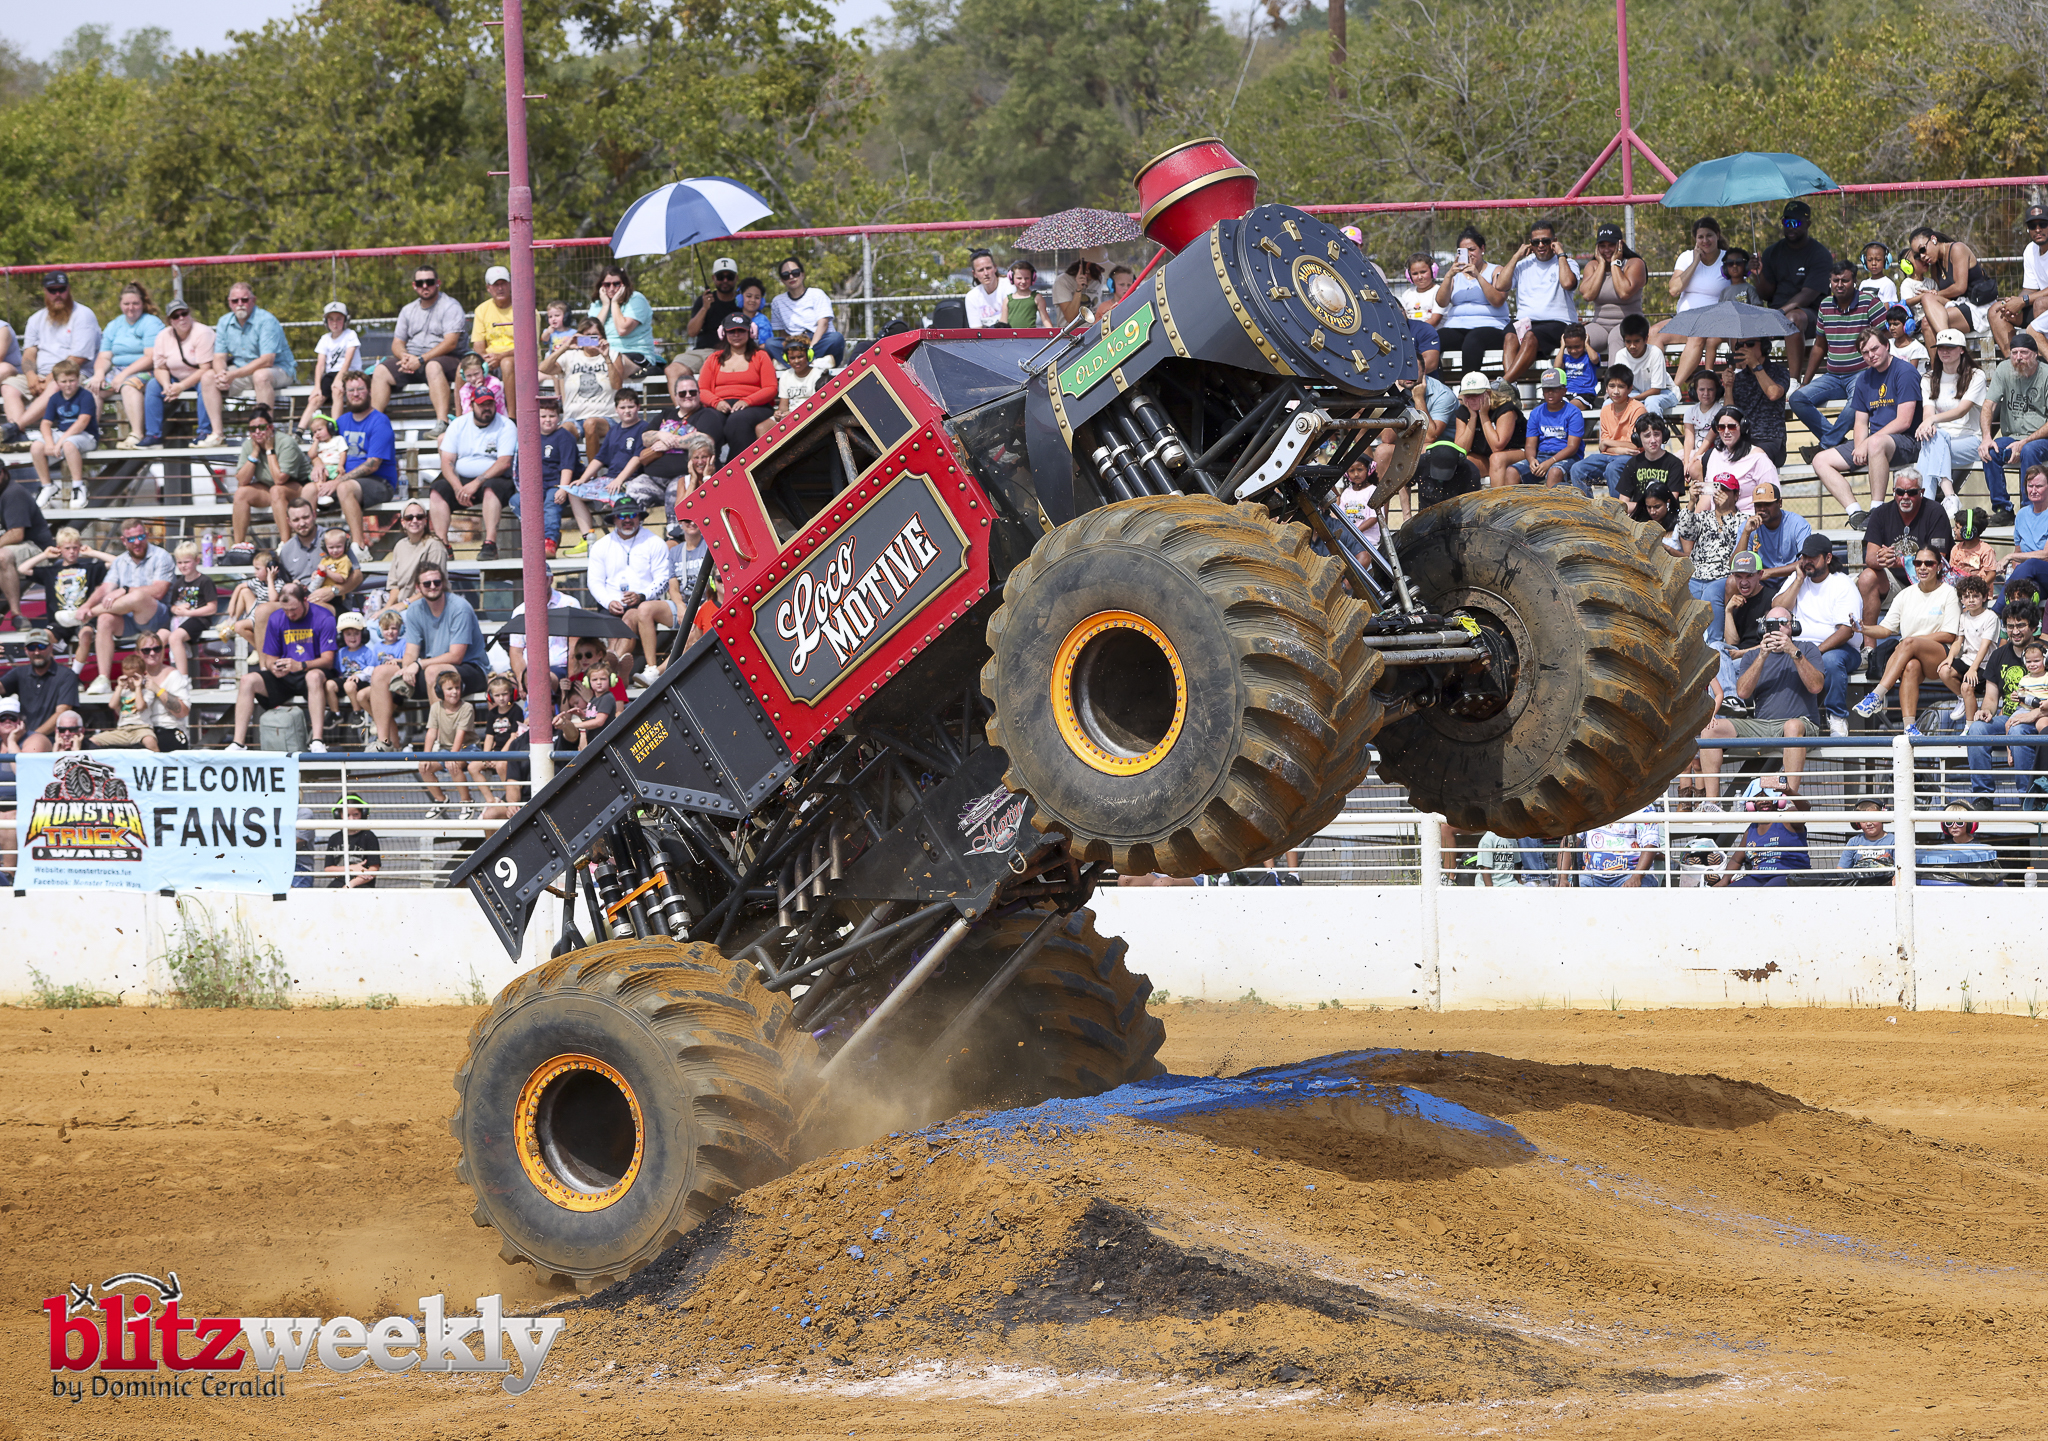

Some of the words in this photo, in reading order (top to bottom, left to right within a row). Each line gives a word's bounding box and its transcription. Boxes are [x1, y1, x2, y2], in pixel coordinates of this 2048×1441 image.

[1124, 319, 1141, 344] 9
[776, 535, 856, 676] Loco
[820, 512, 941, 669] MOTIVE
[629, 719, 664, 757] MIDWEST
[633, 720, 651, 739] THE
[634, 728, 669, 763] EXPRESS
[132, 766, 286, 793] WELCOME
[27, 801, 146, 844] MONSTER
[41, 826, 132, 848] TRUCK
[153, 806, 283, 848] FANS!
[49, 848, 129, 860] WARS
[494, 856, 518, 889] 9
